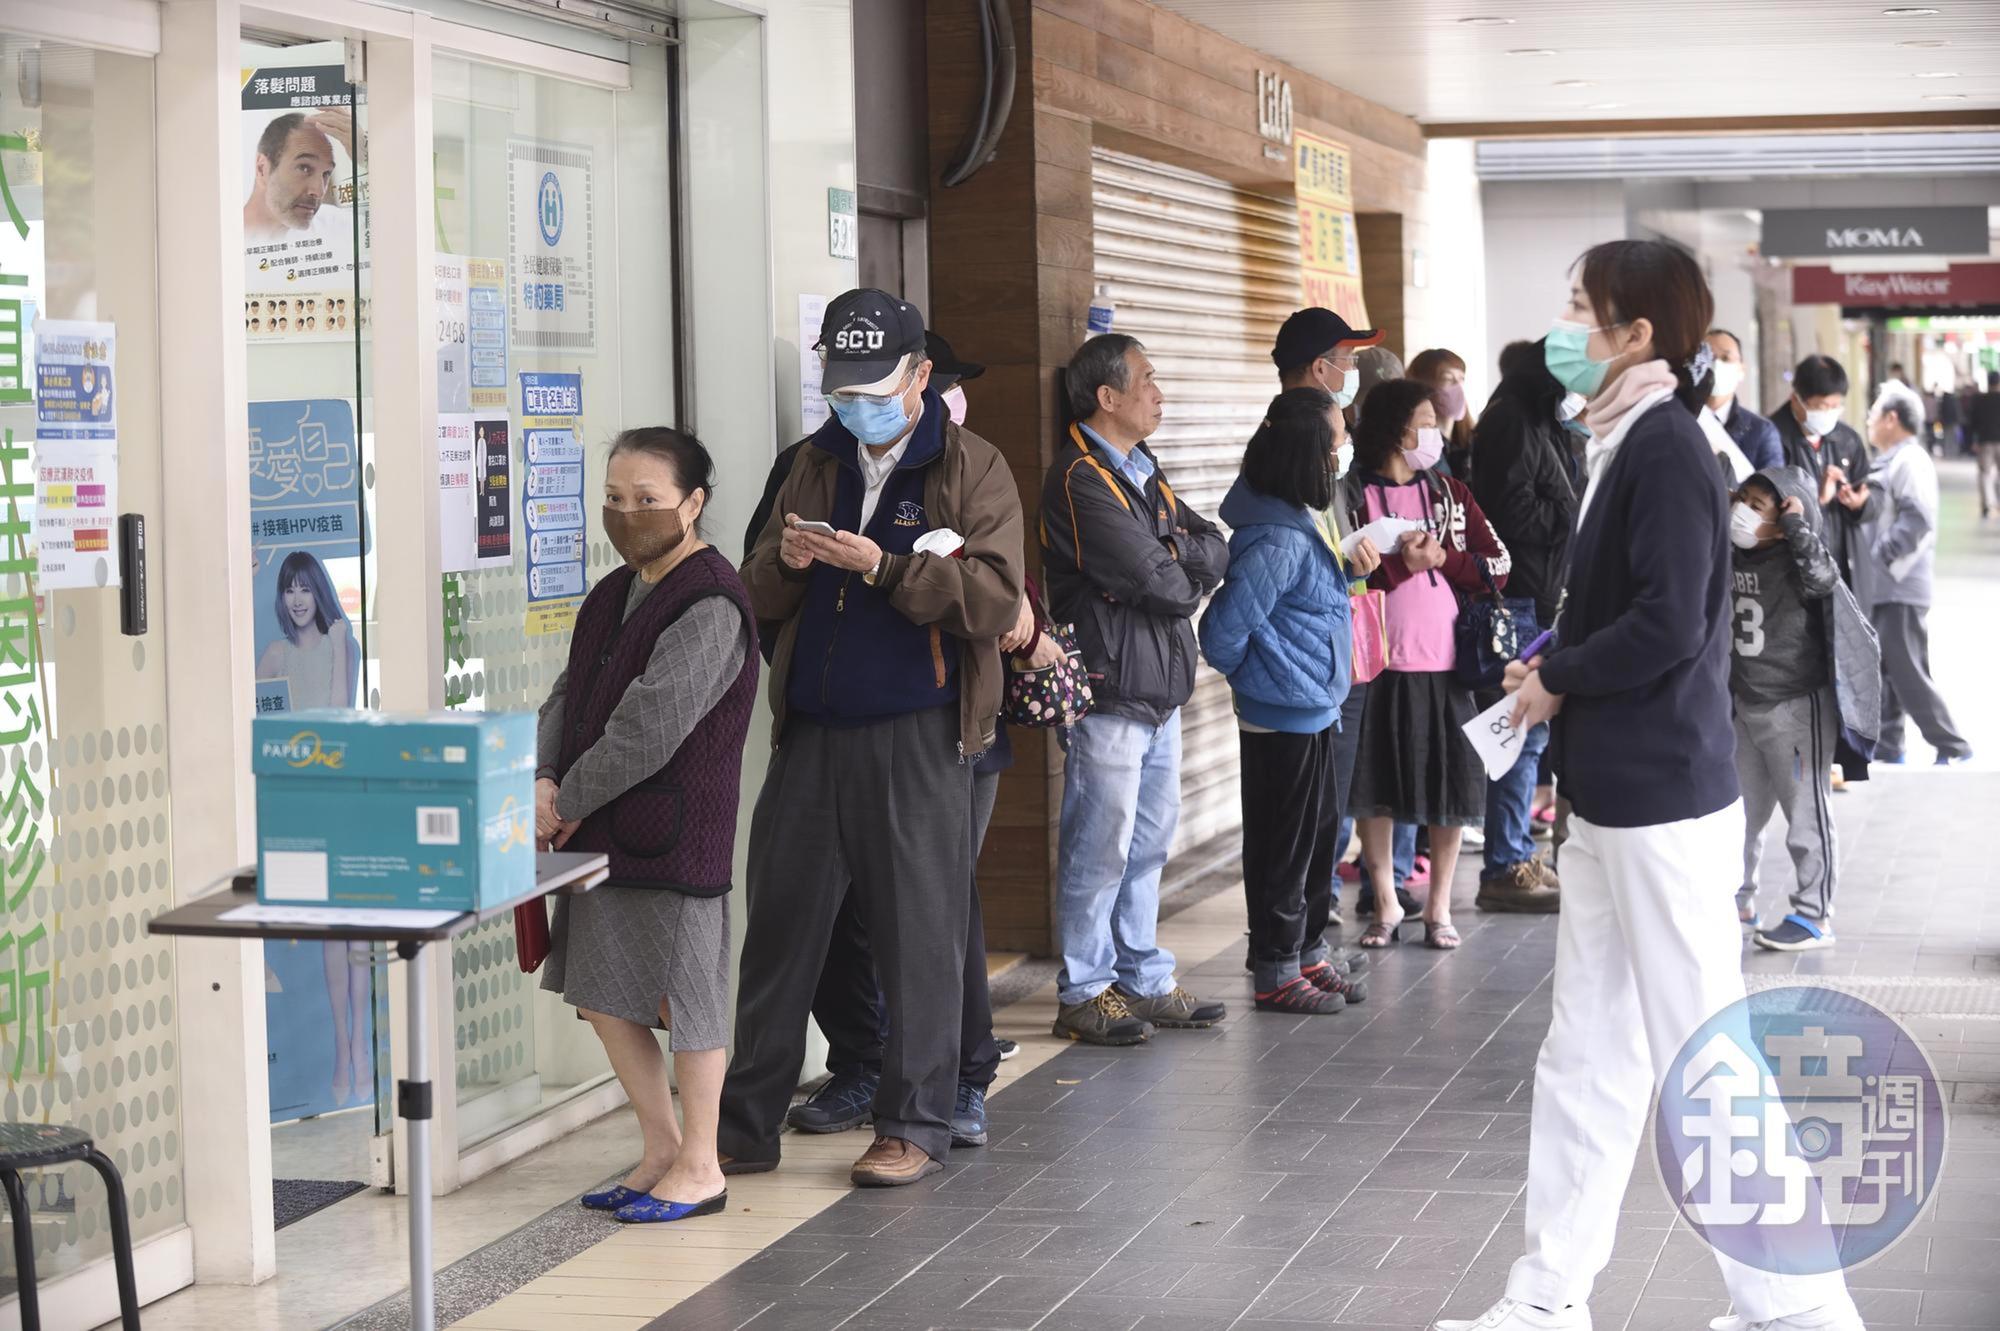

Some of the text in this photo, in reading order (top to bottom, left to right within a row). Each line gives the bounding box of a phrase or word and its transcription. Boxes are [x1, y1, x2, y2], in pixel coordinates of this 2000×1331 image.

[254, 76, 316, 95] 落髮問題
[1826, 227, 1924, 248] MOMA
[259, 257, 267, 270] 2
[287, 268, 295, 280] 3
[1845, 274, 1951, 298] KeyWear
[523, 282, 564, 312] 特約藥局
[835, 330, 885, 349] SCU
[39, 467, 95, 482] 因應武漢肺炎疫情
